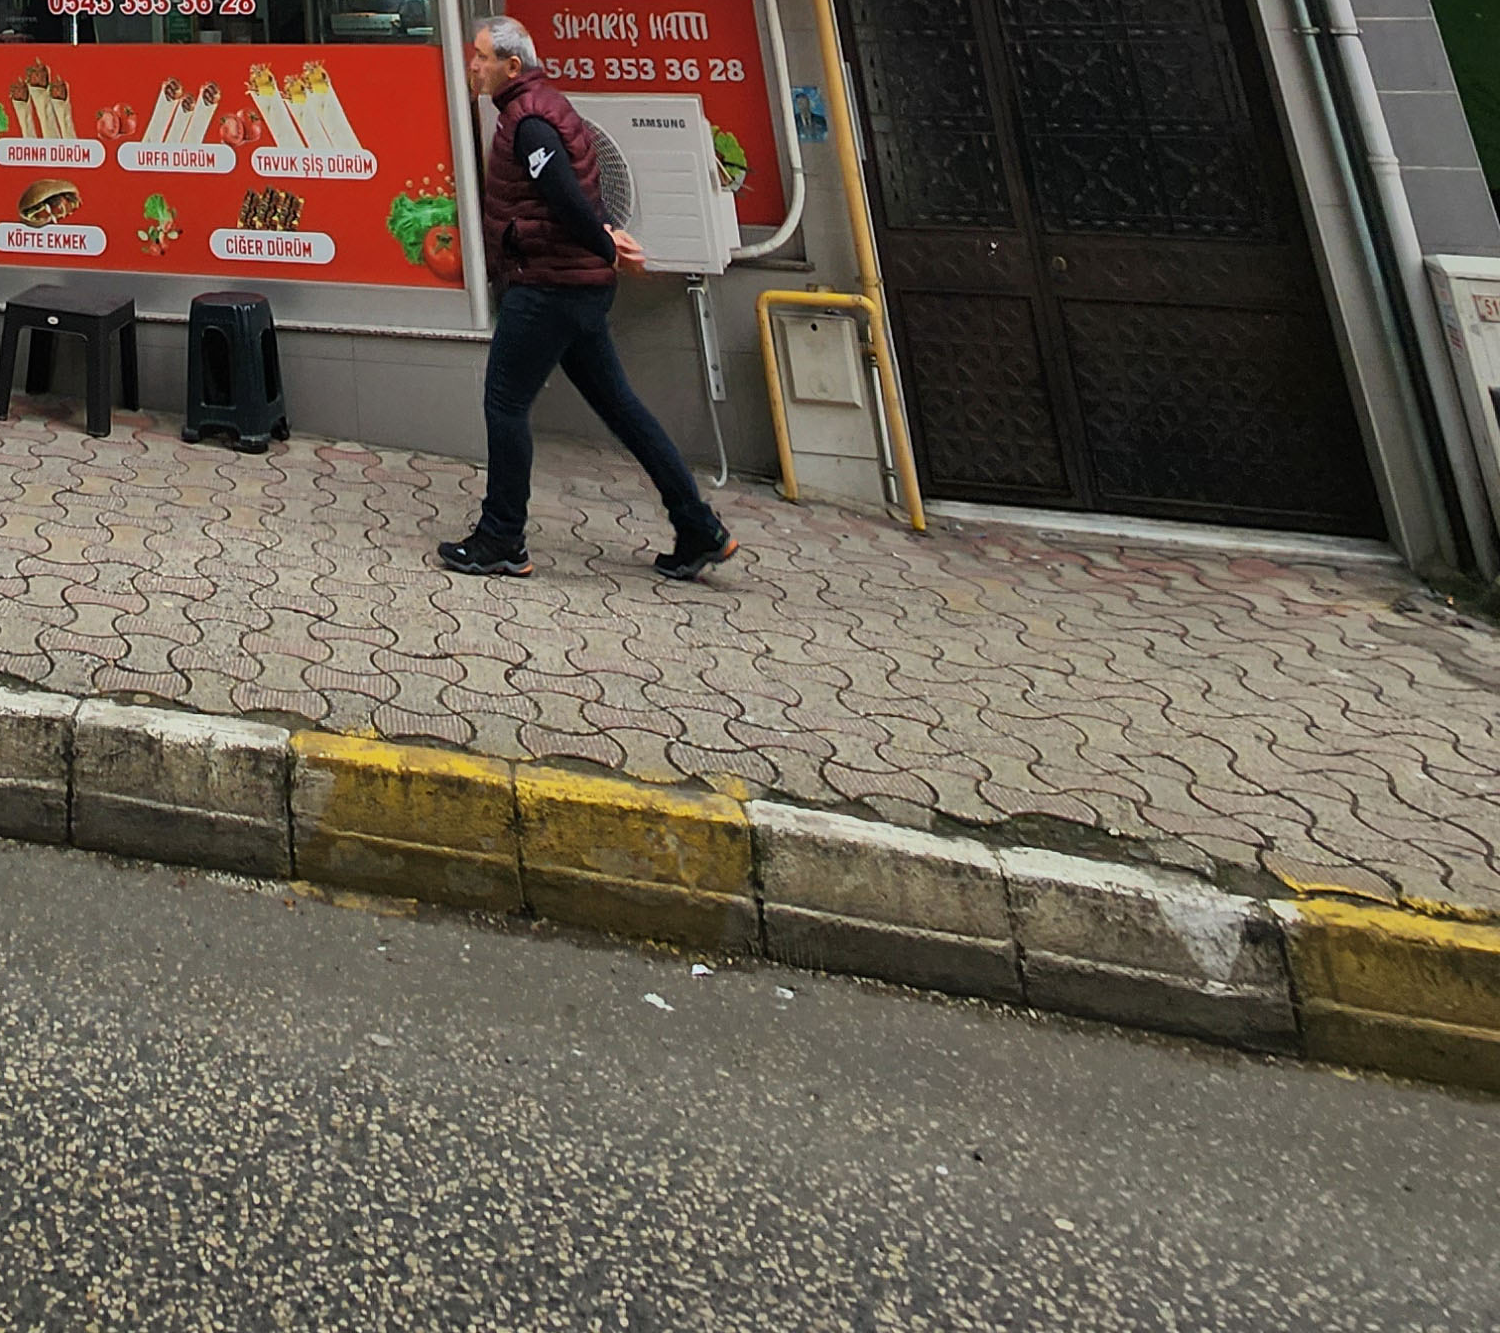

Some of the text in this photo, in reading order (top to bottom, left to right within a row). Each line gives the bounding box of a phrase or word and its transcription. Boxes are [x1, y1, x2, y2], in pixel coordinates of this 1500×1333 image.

[553, 7, 639, 47] SİPARİŞ
[538, 57, 745, 81] 543 353 36 28
[631, 118, 686, 130] SAMSUNG
[7, 145, 90, 163] ADANA DÜRÜM
[137, 150, 216, 168] URFA DÜRÜM
[257, 153, 373, 179] TAVUK ŞİŞ DÜRÜM
[6, 229, 87, 250] KÖFTE EKMEK
[226, 234, 313, 258] CİĞER DÜRÜM
